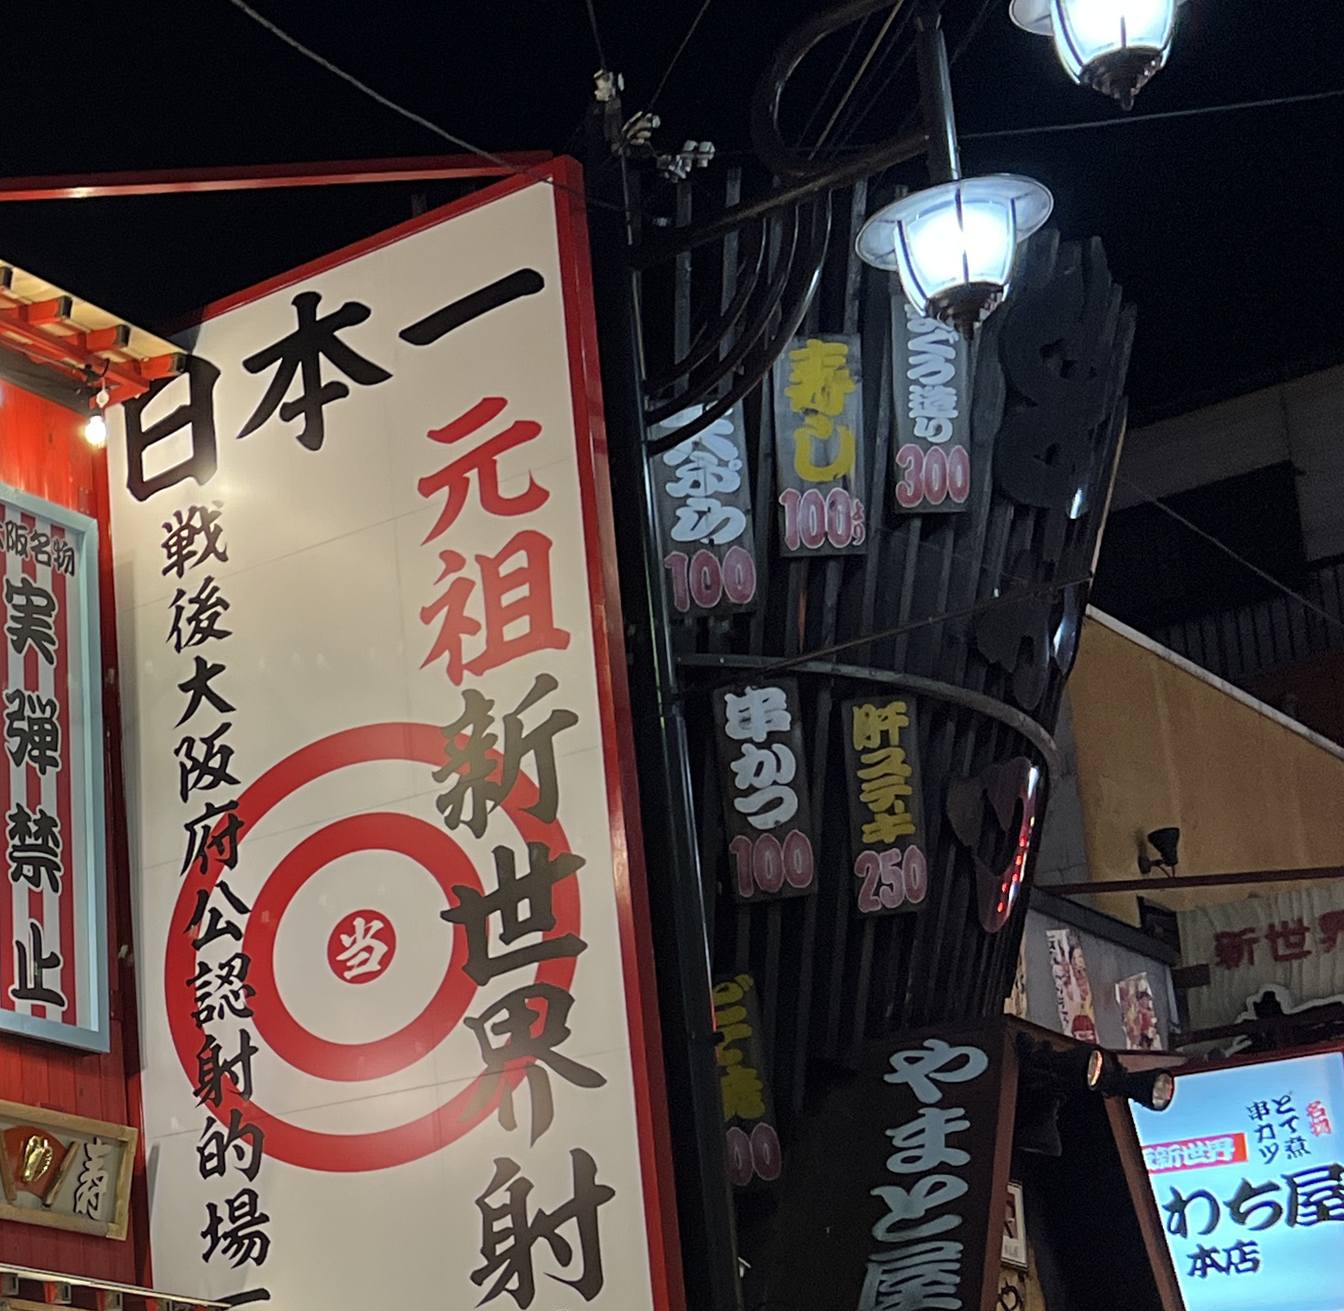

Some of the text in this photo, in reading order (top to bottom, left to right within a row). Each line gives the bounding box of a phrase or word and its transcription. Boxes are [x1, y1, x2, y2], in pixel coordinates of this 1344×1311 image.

[122, 267, 545, 503] 日本一
[895, 443, 970, 508] 300
[664, 545, 757, 612] 100
[724, 685, 799, 831] 串かつ
[2, 575, 68, 1011] 実弾禁止
[728, 829, 814, 899] 100
[853, 845, 928, 913] 250
[1247, 1099, 1280, 1165] 串カツ
[1186, 1238, 1262, 1280] 本店
